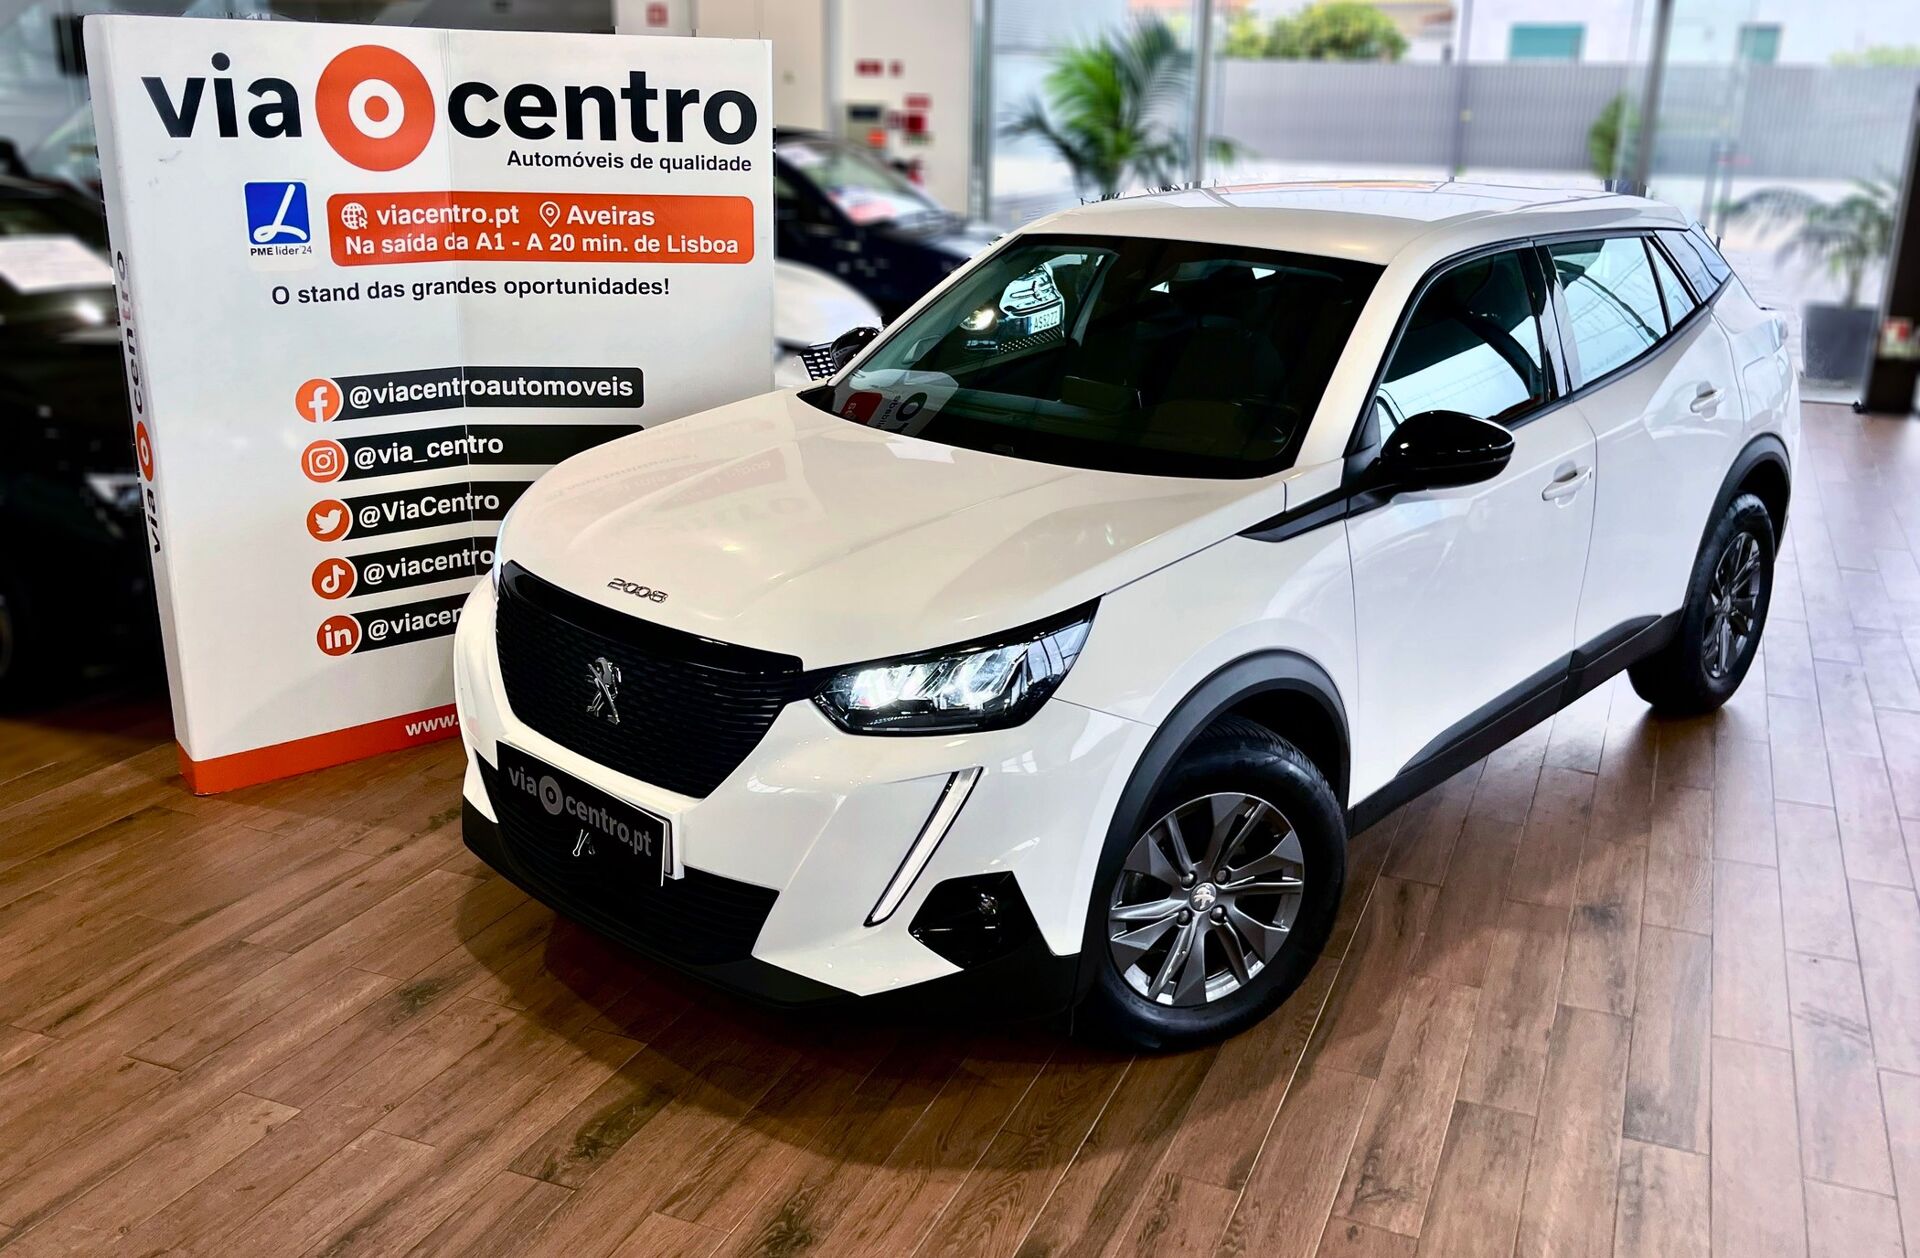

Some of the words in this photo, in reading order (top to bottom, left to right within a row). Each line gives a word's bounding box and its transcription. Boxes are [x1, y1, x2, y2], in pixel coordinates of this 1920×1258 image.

[141, 52, 302, 139] via
[447, 70, 757, 145] centro
[507, 150, 624, 170] Automóveis
[630, 153, 654, 170] de
[659, 154, 752, 174] qualidade
[376, 204, 519, 229] viacentro.pt
[567, 205, 655, 226] Aveiras
[250, 247, 273, 256] PME
[345, 236, 375, 256] Na
[382, 233, 438, 254] saída
[444, 232, 469, 251] da
[476, 232, 505, 251] A1
[526, 233, 543, 251] A
[550, 233, 575, 252] 20
[582, 234, 628, 253] min.
[634, 235, 660, 253] de
[667, 235, 739, 254] Lisboa
[271, 286, 290, 305] O
[298, 282, 360, 304] stand
[367, 281, 405, 300] das
[412, 277, 497, 301] grandes
[504, 277, 670, 299] oportunidades!
[349, 375, 634, 409] @viacentroautomoveis
[353, 434, 504, 470] @via_centro
[358, 492, 500, 529] @ViaCentro
[363, 548, 495, 586] @viacentro
[607, 577, 669, 604] 2008
